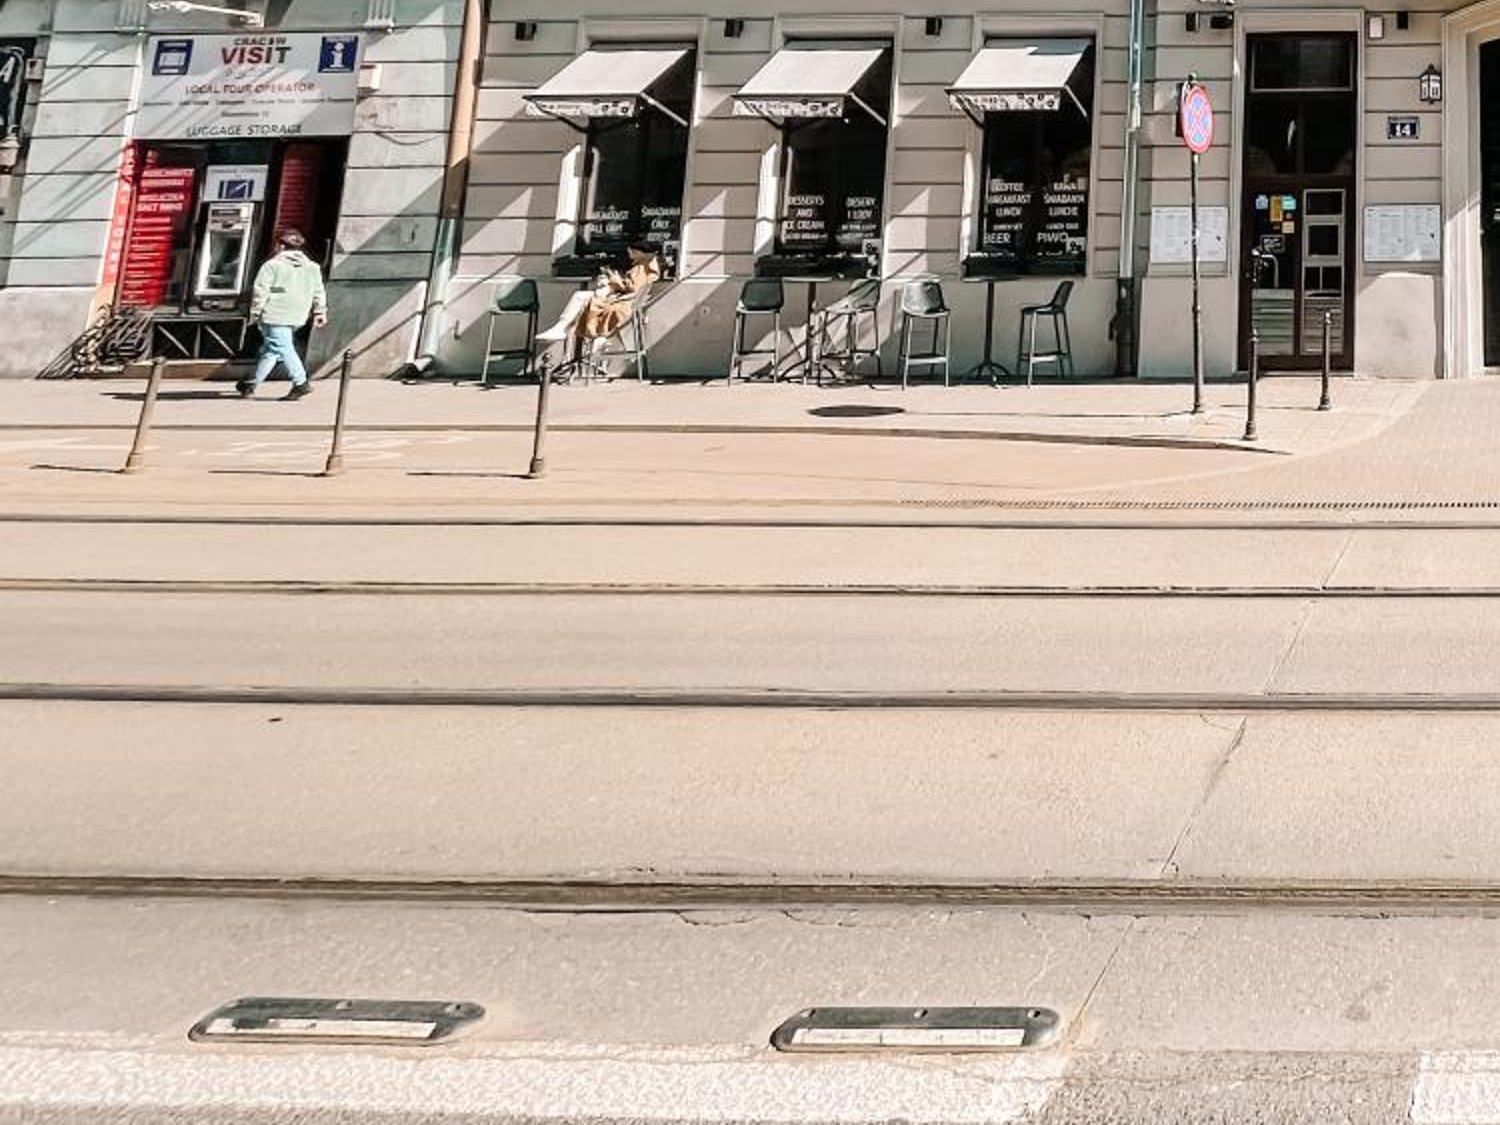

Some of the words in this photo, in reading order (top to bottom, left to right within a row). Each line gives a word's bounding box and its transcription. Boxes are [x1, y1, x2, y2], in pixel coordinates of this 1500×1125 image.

[221, 46, 292, 65] VISIT
[186, 84, 220, 94] LOCAL
[223, 84, 251, 94] TOUR
[254, 82, 316, 94] OPERATOR
[186, 125, 243, 137] LUGGAGE
[247, 124, 303, 136] STORAGE
[1396, 124, 1410, 137] 14
[984, 232, 1011, 244] BEER
[1037, 232, 1069, 244] PIWO
